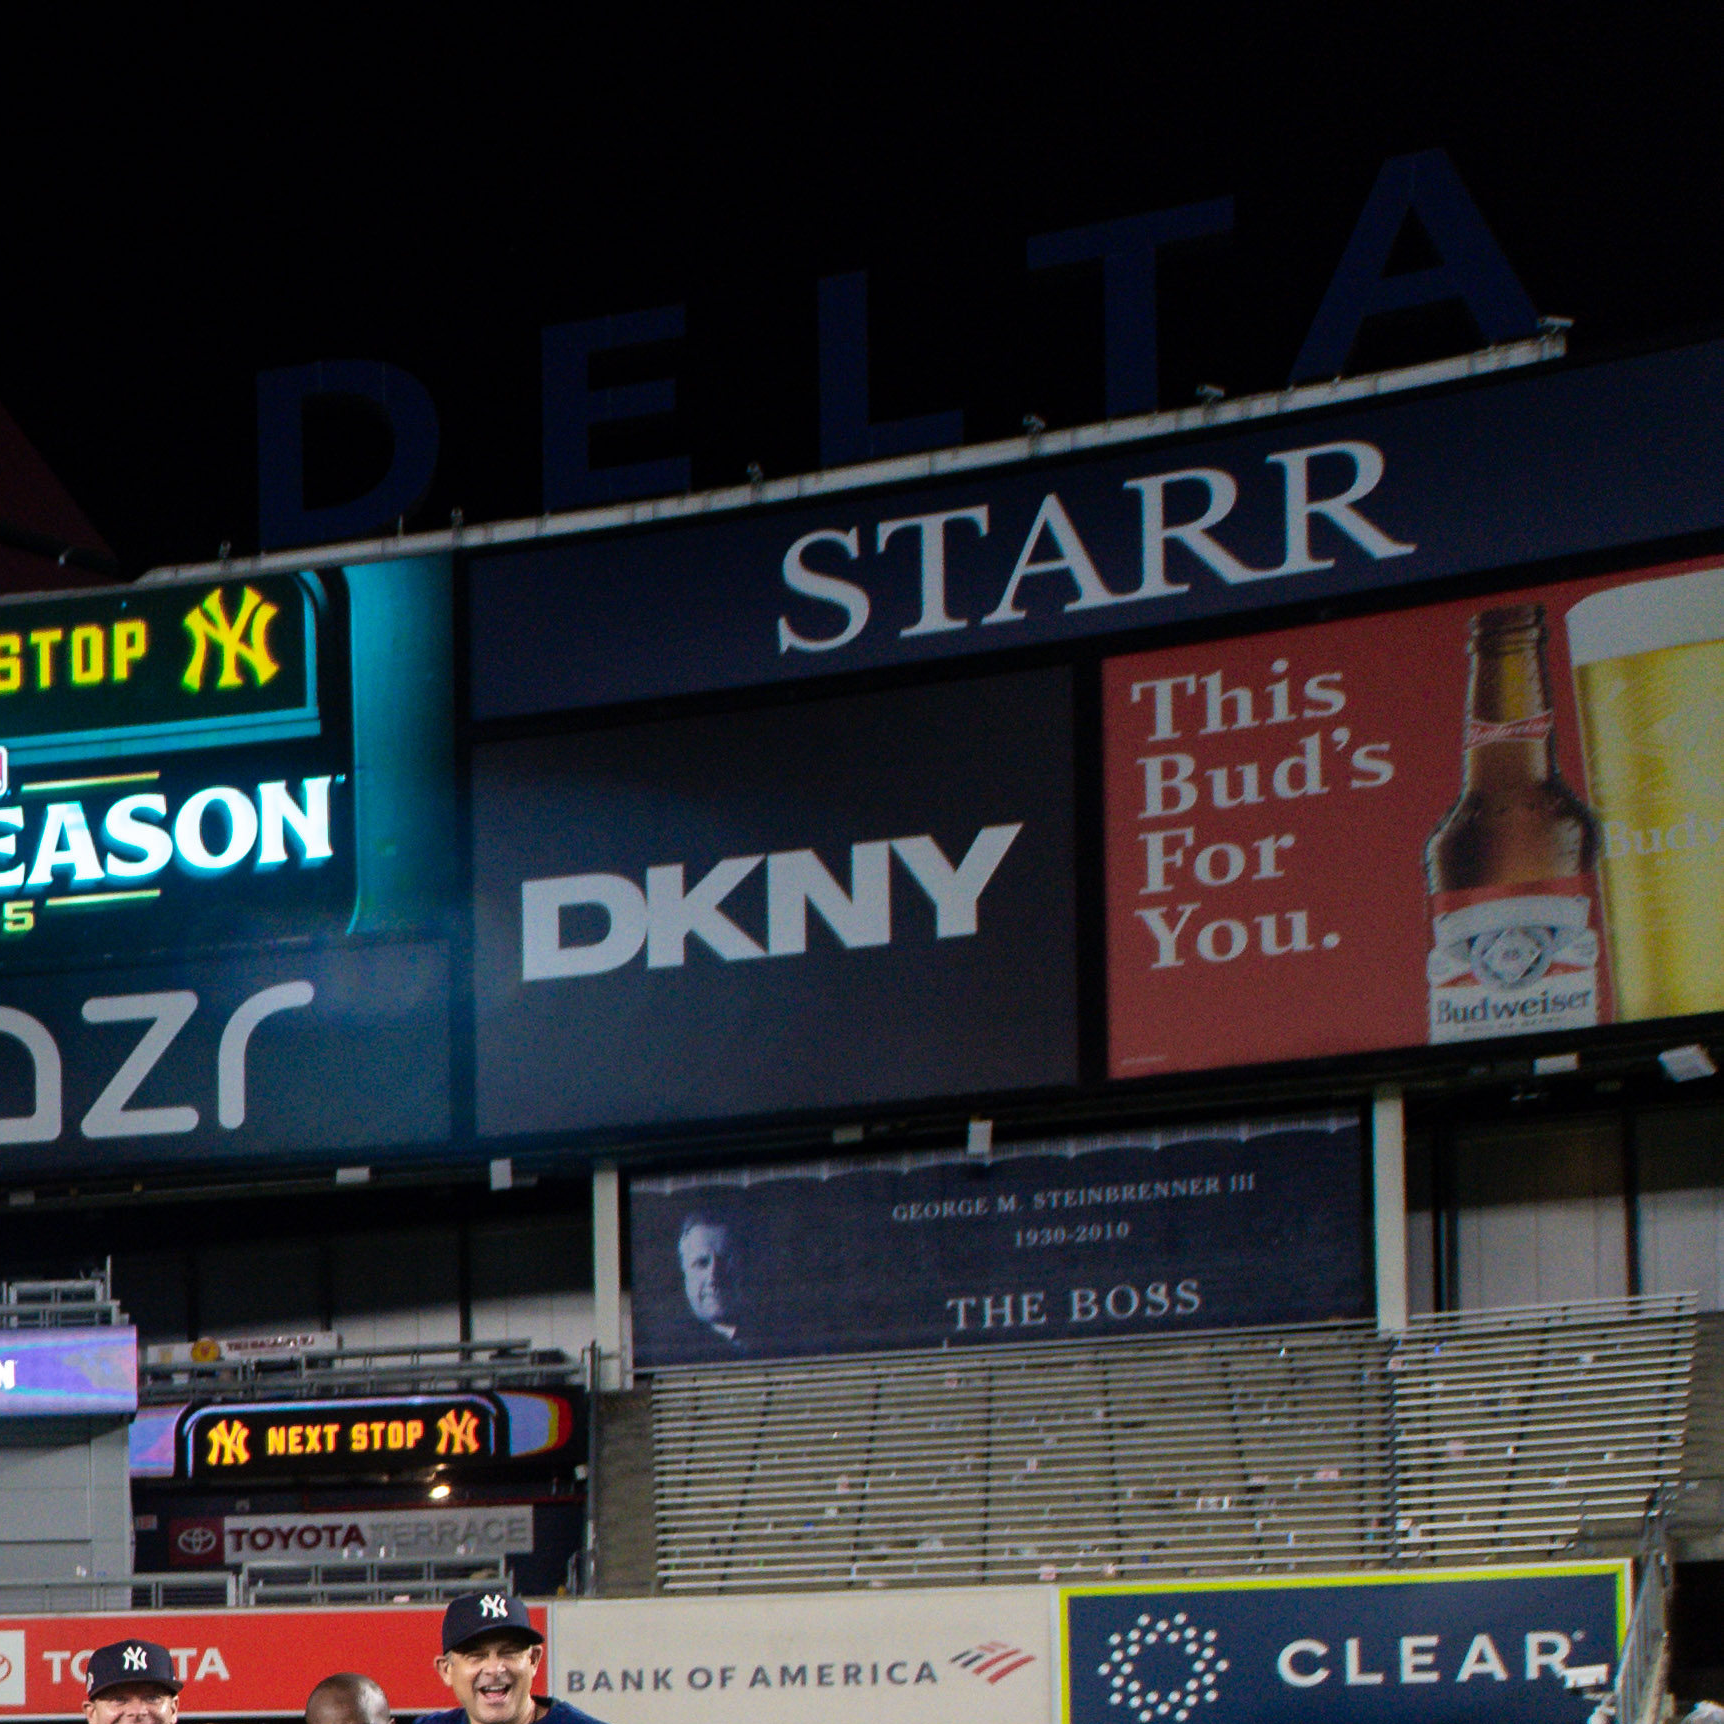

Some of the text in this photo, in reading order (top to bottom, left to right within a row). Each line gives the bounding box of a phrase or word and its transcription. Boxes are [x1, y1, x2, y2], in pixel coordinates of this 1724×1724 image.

[778, 441, 1415, 656] STARR
[1131, 660, 1347, 745] This
[1136, 727, 1394, 820] Bud's
[1137, 826, 1296, 897] For
[522, 822, 1024, 983] DKNY
[1135, 903, 1341, 970] You.
[1436, 986, 1593, 1027] Budweiser
[892, 1172, 1255, 1222] GEORGE M. STEINBRENNER III
[1014, 1221, 1131, 1248] 1930-2010
[945, 1279, 1201, 1332] THE BOSS
[267, 1419, 424, 1455] NEXT STOP
[228, 1517, 526, 1552] TOYOTA TERRACE
[43, 1648, 230, 1682] TOTA
[566, 1659, 940, 1695] BANK OF AMERICA
[1278, 1632, 1571, 1689] CLEAR
